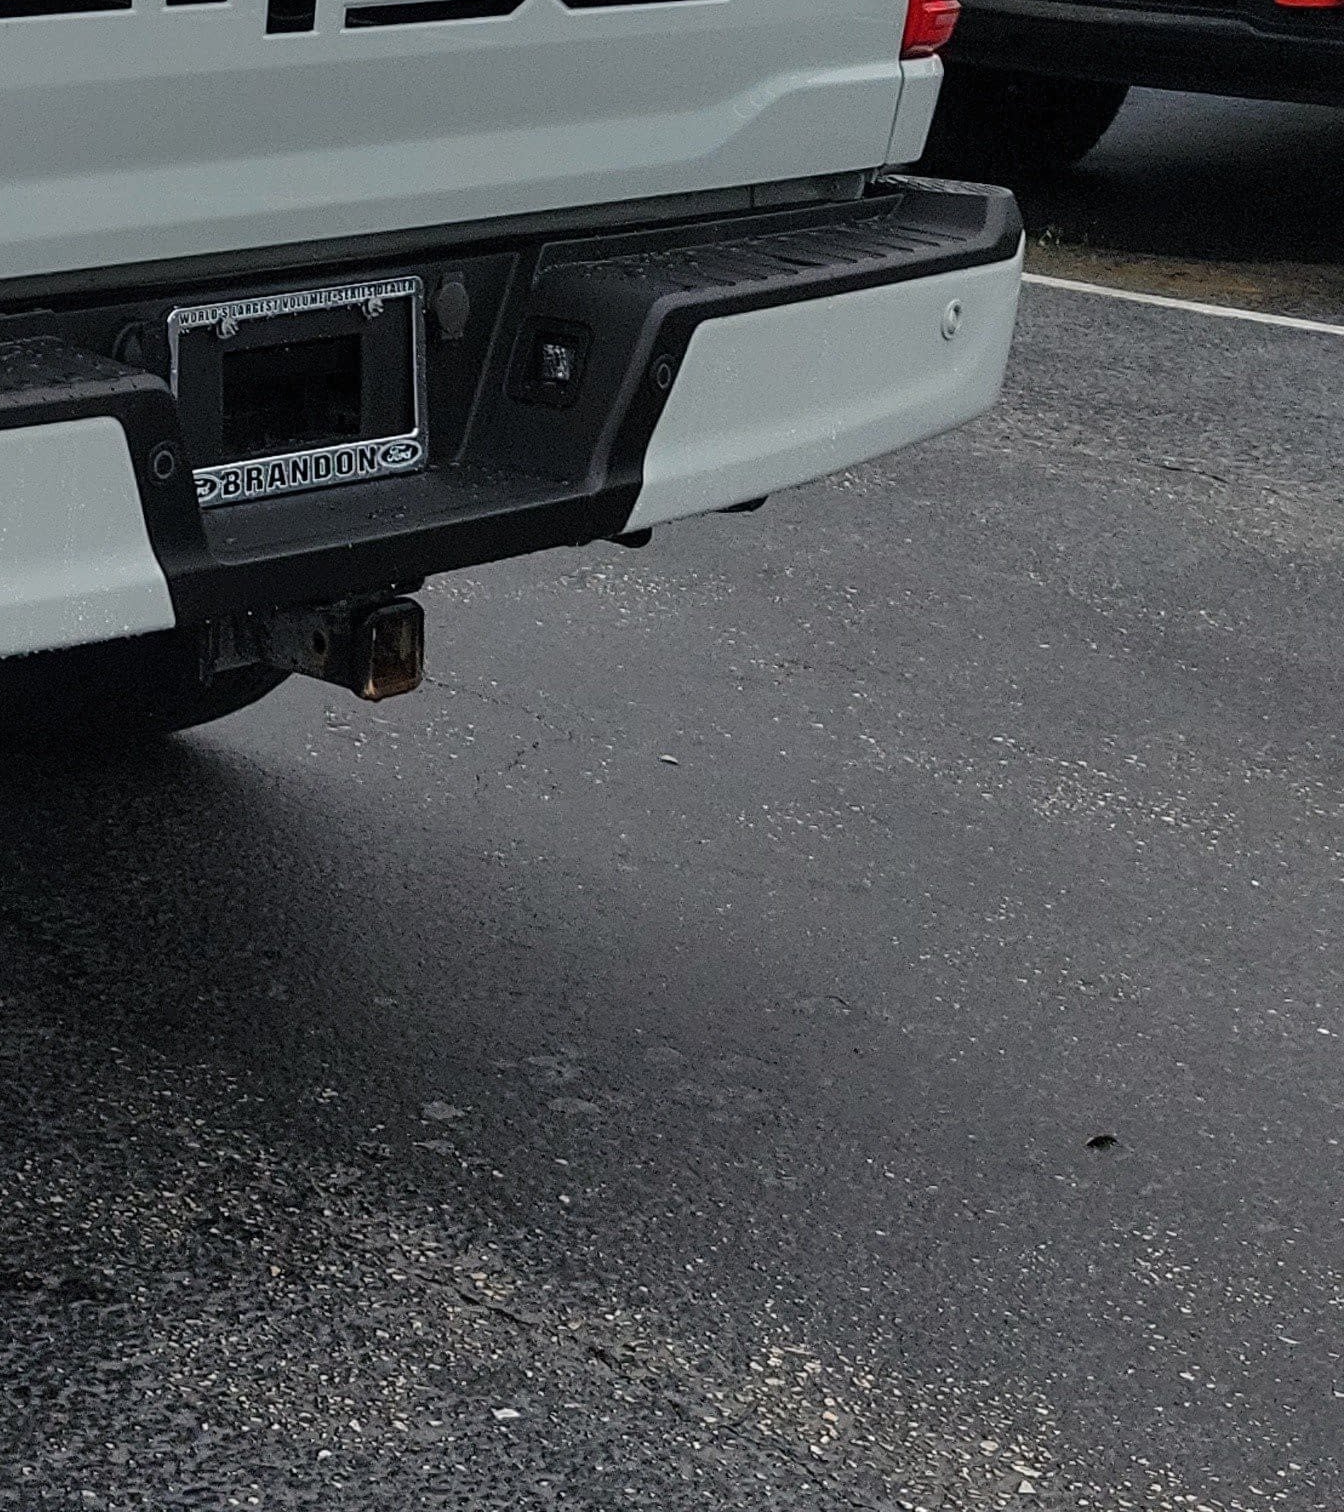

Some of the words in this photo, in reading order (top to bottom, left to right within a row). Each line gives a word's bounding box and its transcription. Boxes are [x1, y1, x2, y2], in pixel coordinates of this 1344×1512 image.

[179, 307, 229, 325] WORLD'S
[232, 299, 278, 317] LARGEST
[281, 290, 325, 309] VOLUME
[376, 279, 415, 296] DEALER
[222, 444, 377, 498] BRANDON
[387, 445, 412, 462] Ford
